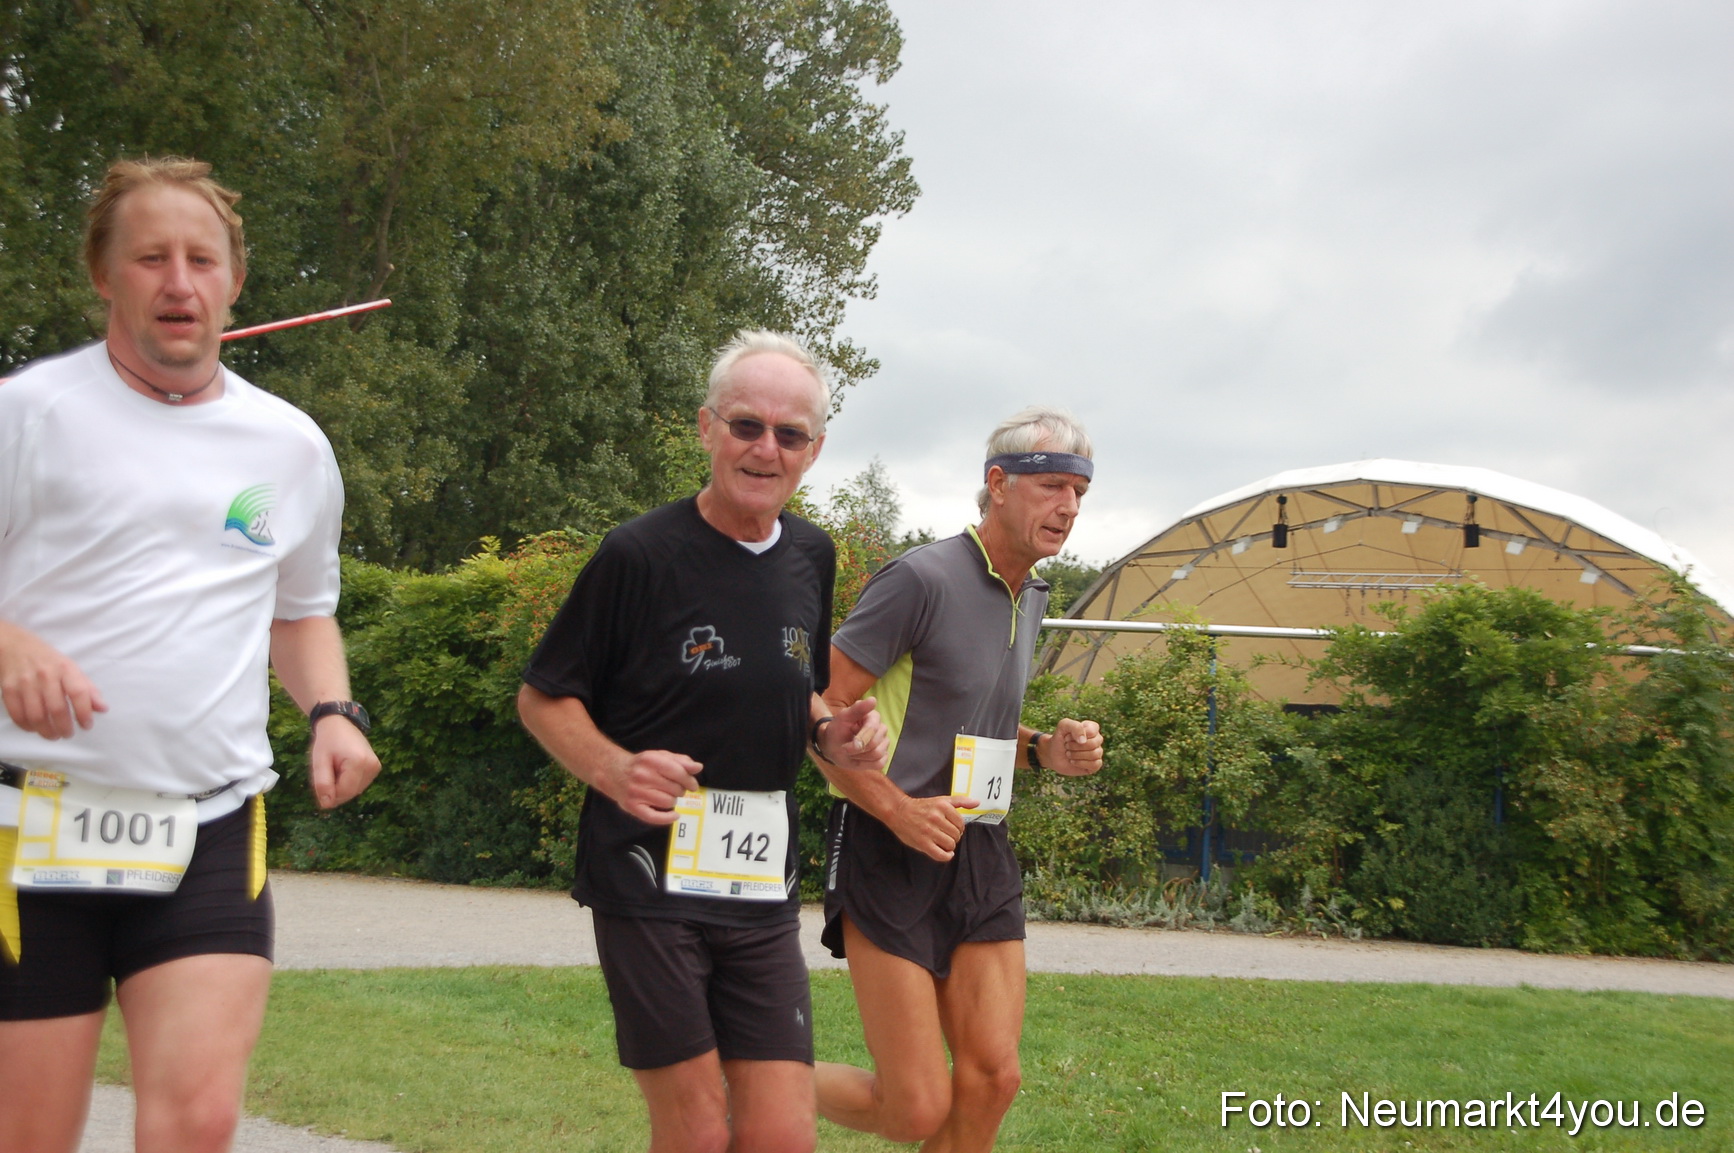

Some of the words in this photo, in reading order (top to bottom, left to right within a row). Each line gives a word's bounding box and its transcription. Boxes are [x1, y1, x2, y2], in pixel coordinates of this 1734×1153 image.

[987, 776, 1002, 800] 13
[712, 792, 744, 816] Willi
[74, 807, 177, 848] 1001
[678, 822, 687, 838] B
[721, 829, 770, 862] 142
[126, 869, 182, 884] PFLEIDERER
[742, 881, 783, 893] PFLEIDERER
